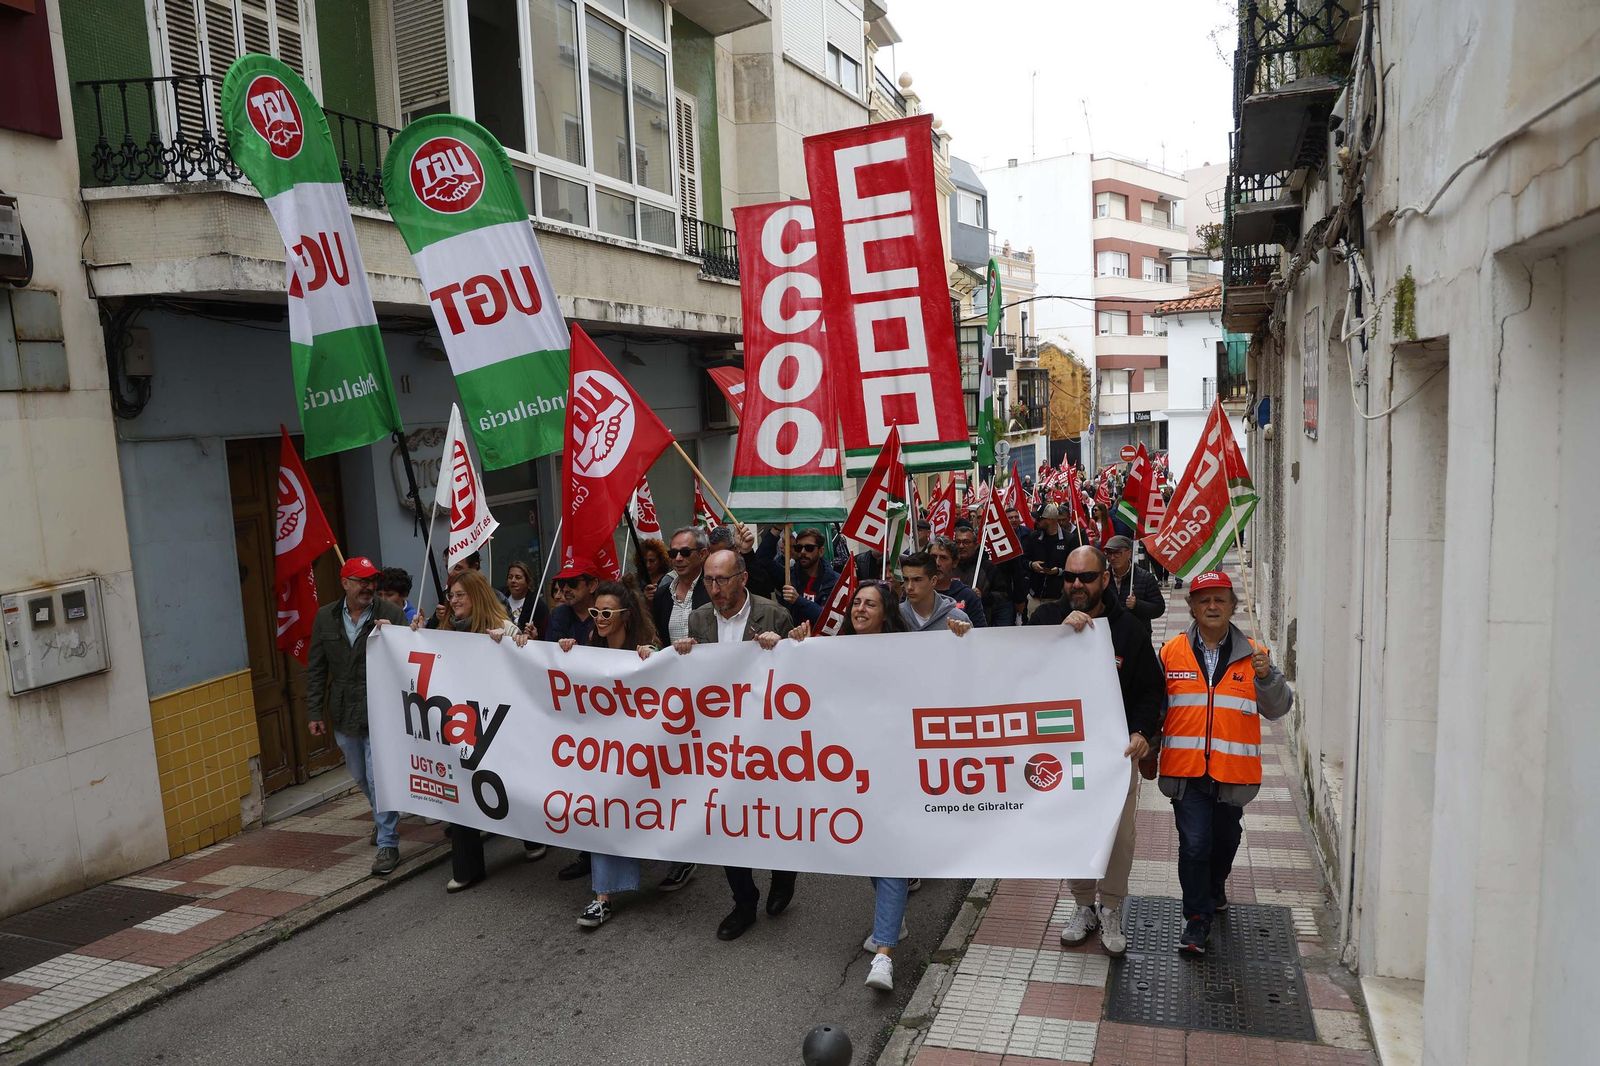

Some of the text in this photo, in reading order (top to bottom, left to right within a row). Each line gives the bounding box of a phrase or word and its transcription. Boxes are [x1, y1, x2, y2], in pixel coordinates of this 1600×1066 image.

[833, 136, 940, 446] CCOO
[1197, 572, 1219, 582] CCOO
[1167, 671, 1190, 680] CCOO
[547, 668, 811, 735] Proteger lo
[921, 711, 1029, 741] CCOO
[401, 690, 511, 820] mayo
[410, 754, 433, 775] UGT
[551, 729, 870, 794] conquistado,
[412, 777, 444, 797] CCOO
[918, 755, 1015, 796] UGT
[543, 788, 864, 844] ganar futuro
[924, 801, 1024, 814] Campo de Gibraltar
